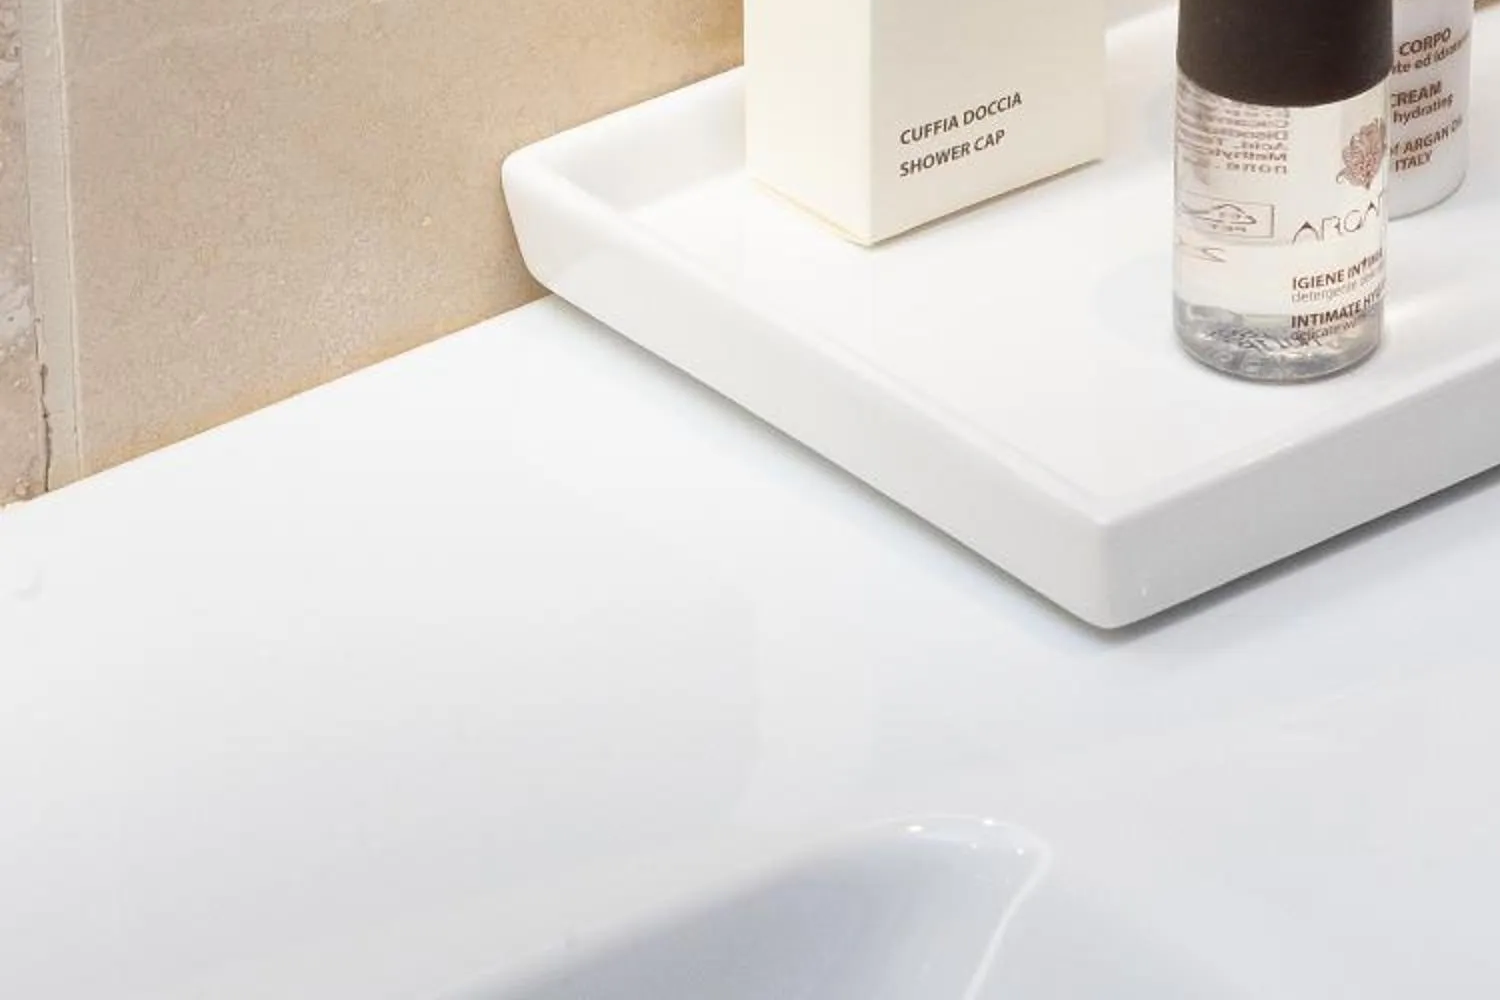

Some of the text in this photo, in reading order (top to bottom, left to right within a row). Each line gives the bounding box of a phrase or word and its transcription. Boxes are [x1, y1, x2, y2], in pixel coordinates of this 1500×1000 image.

[1399, 31, 1451, 58] CORPO
[900, 91, 1023, 145] CUFFIA DOCCIA
[1393, 94, 1454, 126] hydrating
[899, 128, 1006, 178] SHOWER CAP
[1402, 125, 1449, 155] ARGAN
[1395, 149, 1433, 172] ITALY
[1293, 267, 1345, 291] IGIENE
[1291, 299, 1361, 328] INTIMATE
